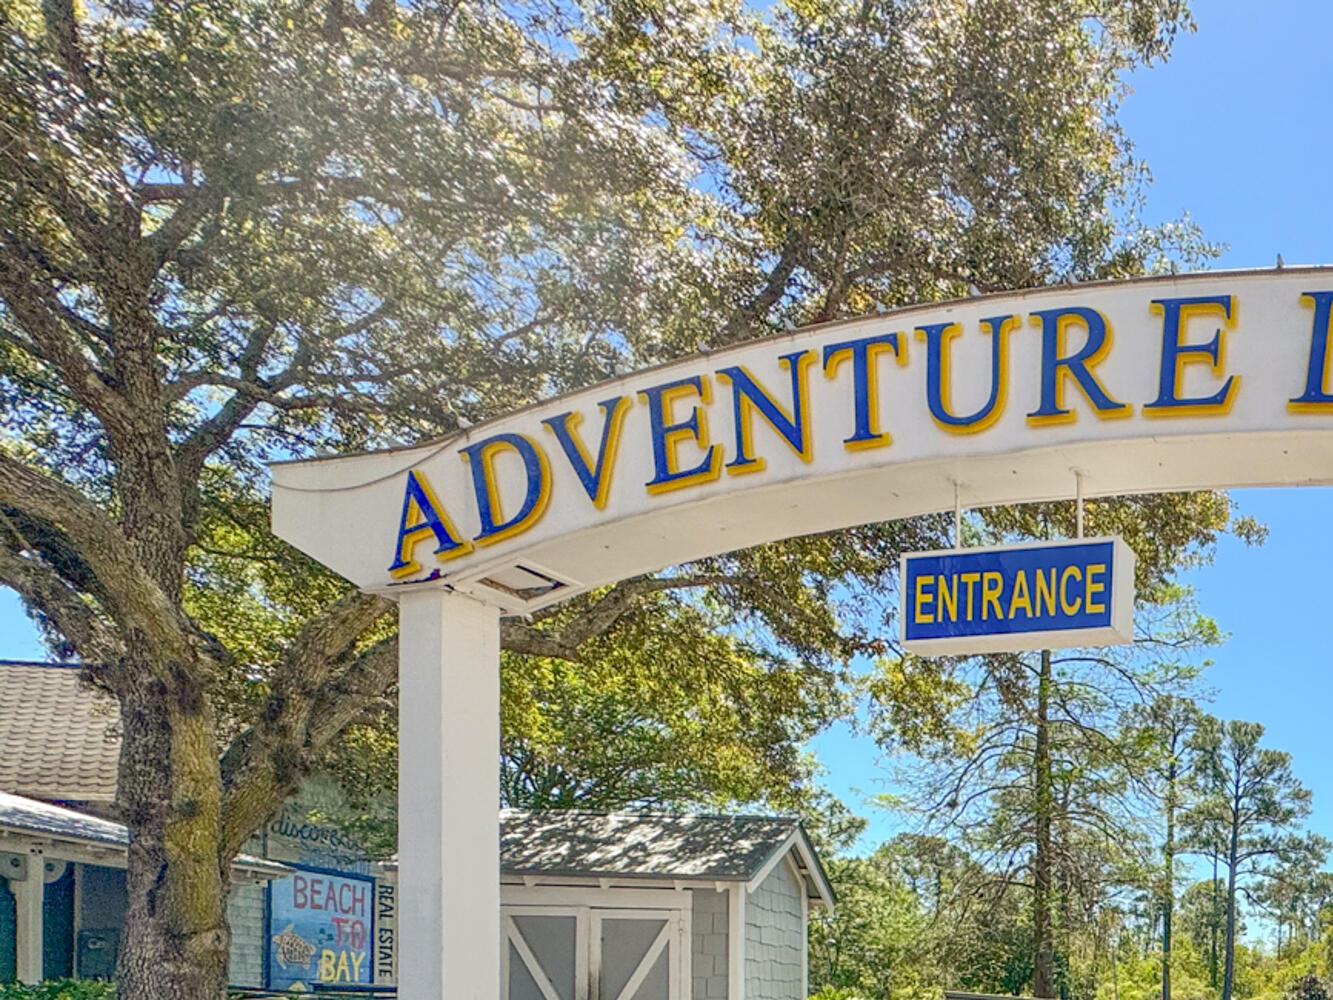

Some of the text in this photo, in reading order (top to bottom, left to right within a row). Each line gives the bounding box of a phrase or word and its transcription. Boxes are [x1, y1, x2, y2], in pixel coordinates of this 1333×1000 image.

[388, 294, 1241, 579] ADVENTURE
[915, 564, 1106, 624] ENTRANCE
[293, 875, 366, 917] BEACH
[331, 916, 366, 950] TO
[378, 885, 394, 978] REAL ESTATE
[321, 950, 366, 982] BAY
